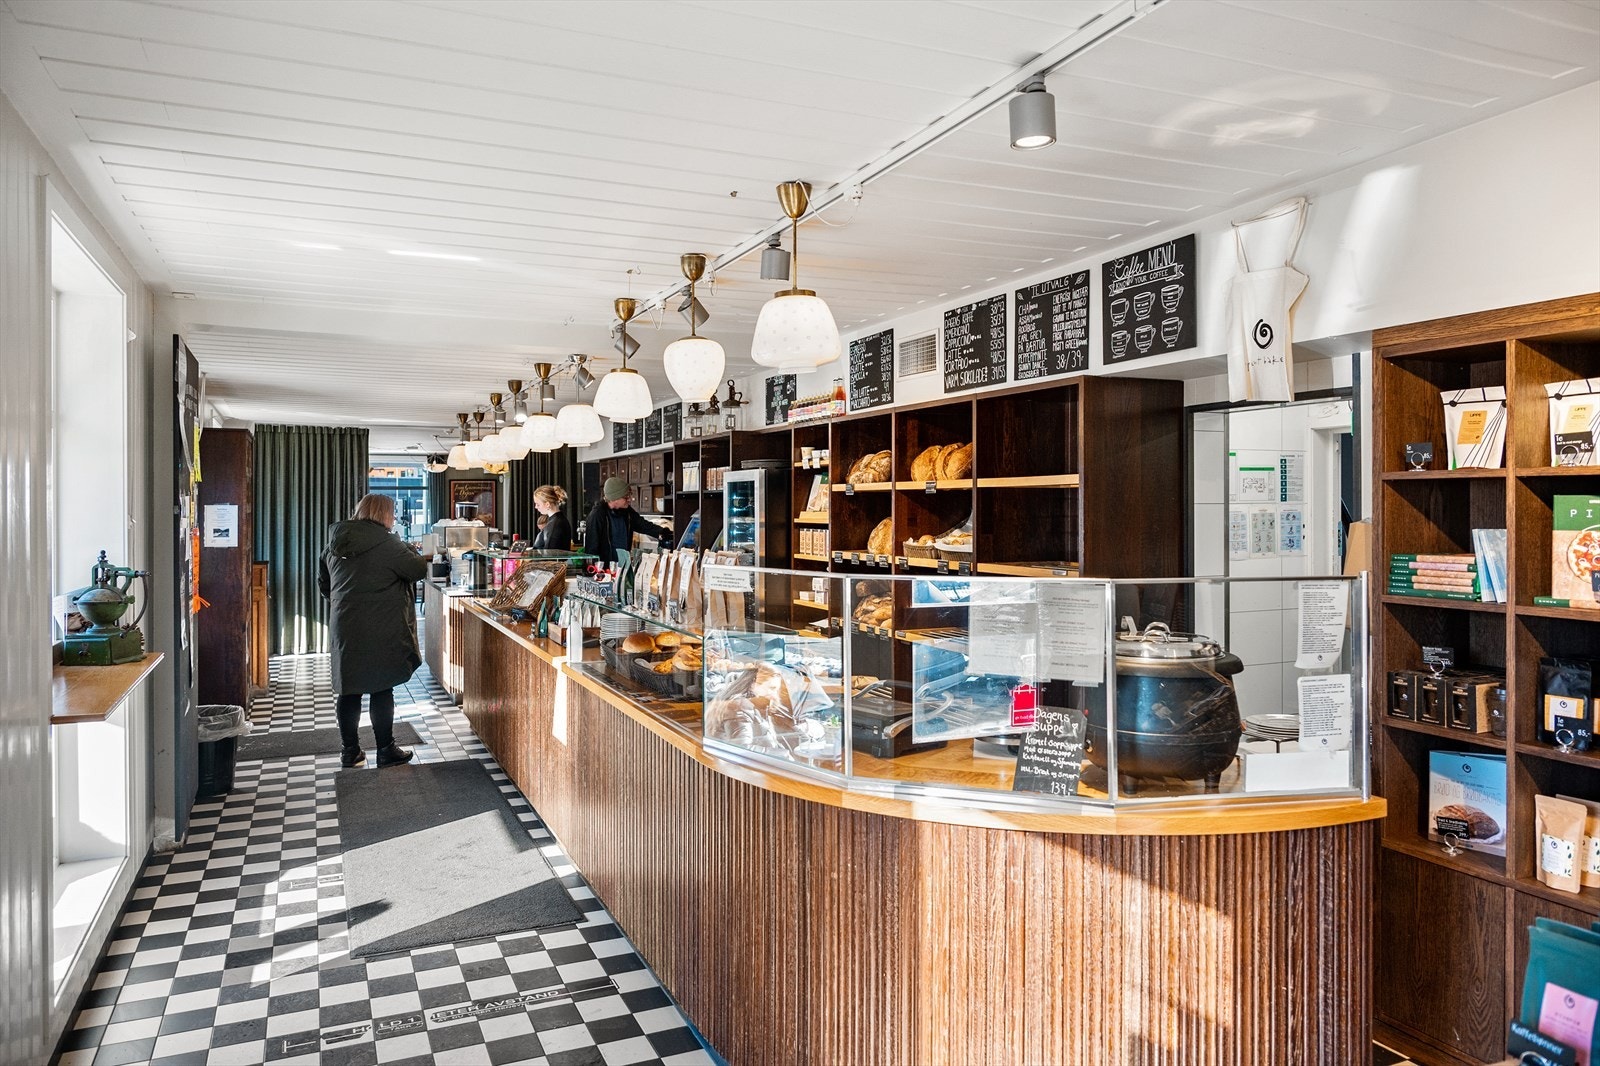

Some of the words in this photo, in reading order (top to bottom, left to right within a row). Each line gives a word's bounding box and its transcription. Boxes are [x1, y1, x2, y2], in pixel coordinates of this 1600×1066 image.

[1148, 244, 1176, 270] MENU
[1042, 276, 1068, 292] UTVALG
[1134, 276, 1147, 284] YOUR
[1150, 269, 1168, 280] COFFEE
[945, 348, 961, 362] LATTE
[945, 357, 968, 374] CORTADO
[1034, 708, 1070, 724] Dagens
[484, 990, 559, 1008] AVSTAND
